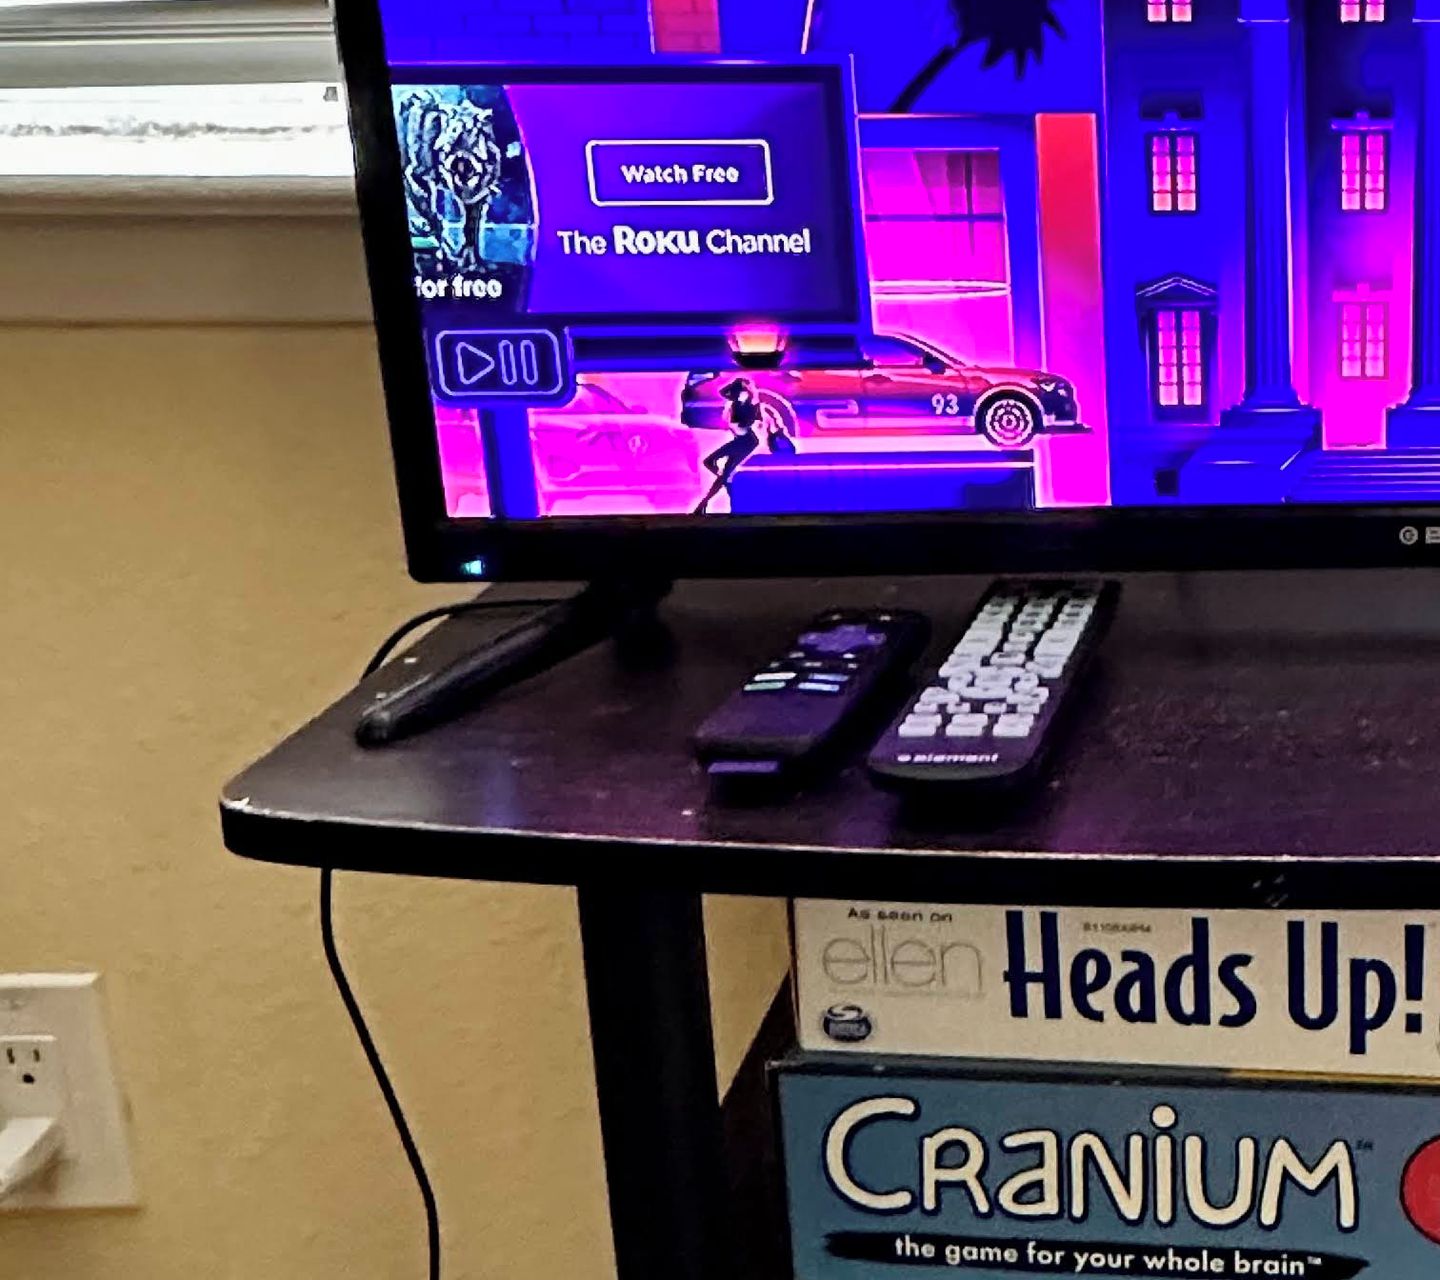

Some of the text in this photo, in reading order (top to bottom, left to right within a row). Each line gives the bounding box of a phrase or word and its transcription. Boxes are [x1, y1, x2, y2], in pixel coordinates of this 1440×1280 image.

[620, 164, 740, 186] Watch Free
[557, 229, 607, 255] The
[705, 228, 812, 255] Channel
[452, 273, 503, 299] free
[931, 393, 960, 415] 93
[847, 907, 953, 923] As seen on
[822, 924, 985, 991] ellen
[1003, 909, 1425, 1055] Heads Up!
[896, 1236, 936, 1258] the
[945, 1243, 1019, 1266] game
[1026, 1241, 1064, 1266] for
[1074, 1251, 1136, 1273] your
[1143, 1251, 1226, 1274] whole
